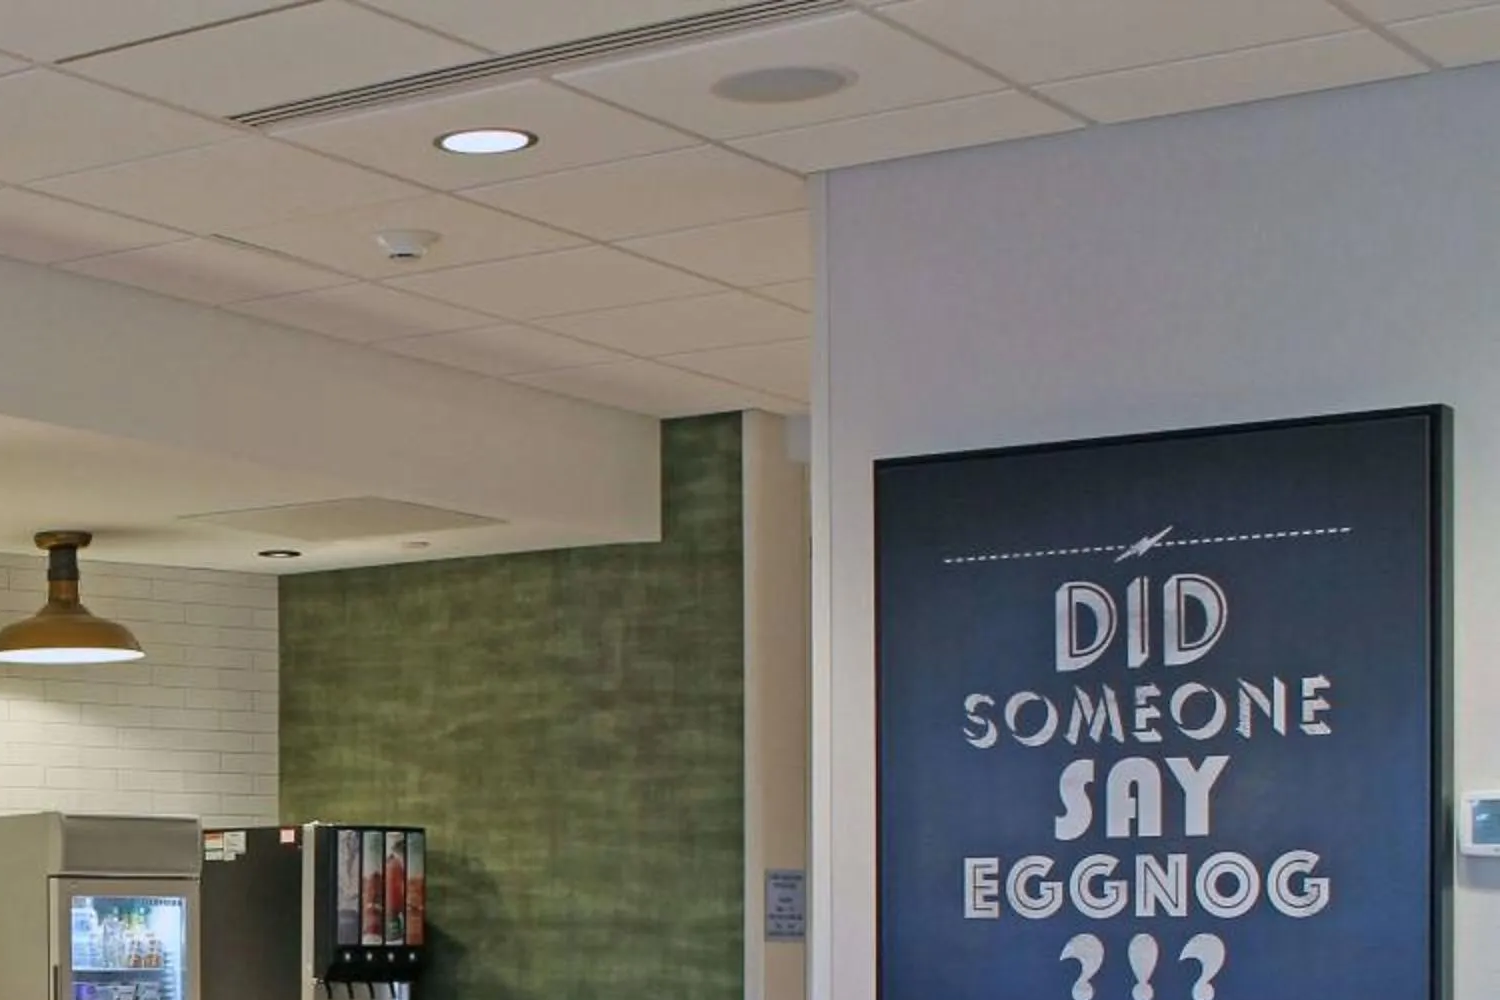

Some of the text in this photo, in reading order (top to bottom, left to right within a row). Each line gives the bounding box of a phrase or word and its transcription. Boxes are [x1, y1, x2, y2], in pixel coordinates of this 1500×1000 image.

[1056, 573, 1228, 672] DID
[963, 674, 1332, 748] SOMEONE
[1055, 756, 1230, 841] SAY
[964, 850, 1330, 919] EGGNOG
